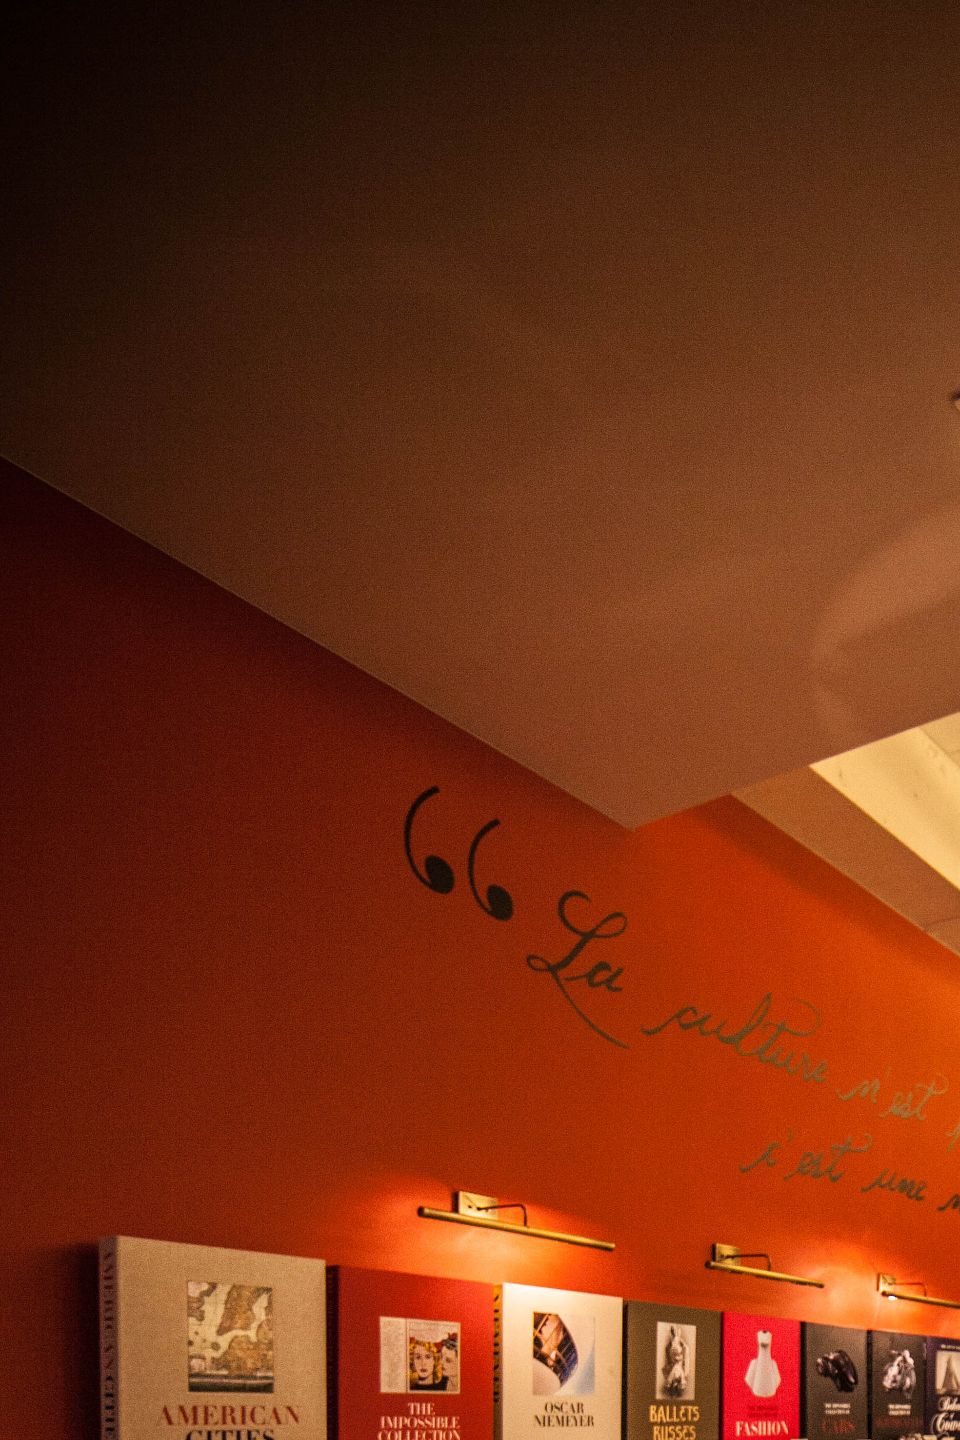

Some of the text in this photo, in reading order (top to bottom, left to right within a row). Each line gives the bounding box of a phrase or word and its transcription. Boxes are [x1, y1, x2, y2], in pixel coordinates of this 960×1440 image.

[526, 889, 632, 1049] La
[641, 992, 827, 1084] culture
[861, 1166, 928, 1202] une
[160, 1404, 300, 1426] AMERICAN
[407, 1402, 436, 1417] THE
[544, 1401, 585, 1414] OSCAR
[379, 1416, 461, 1430] IMPOSSIBLE
[534, 1415, 595, 1428] NIEMEYER
[735, 1420, 790, 1437] FASHION
